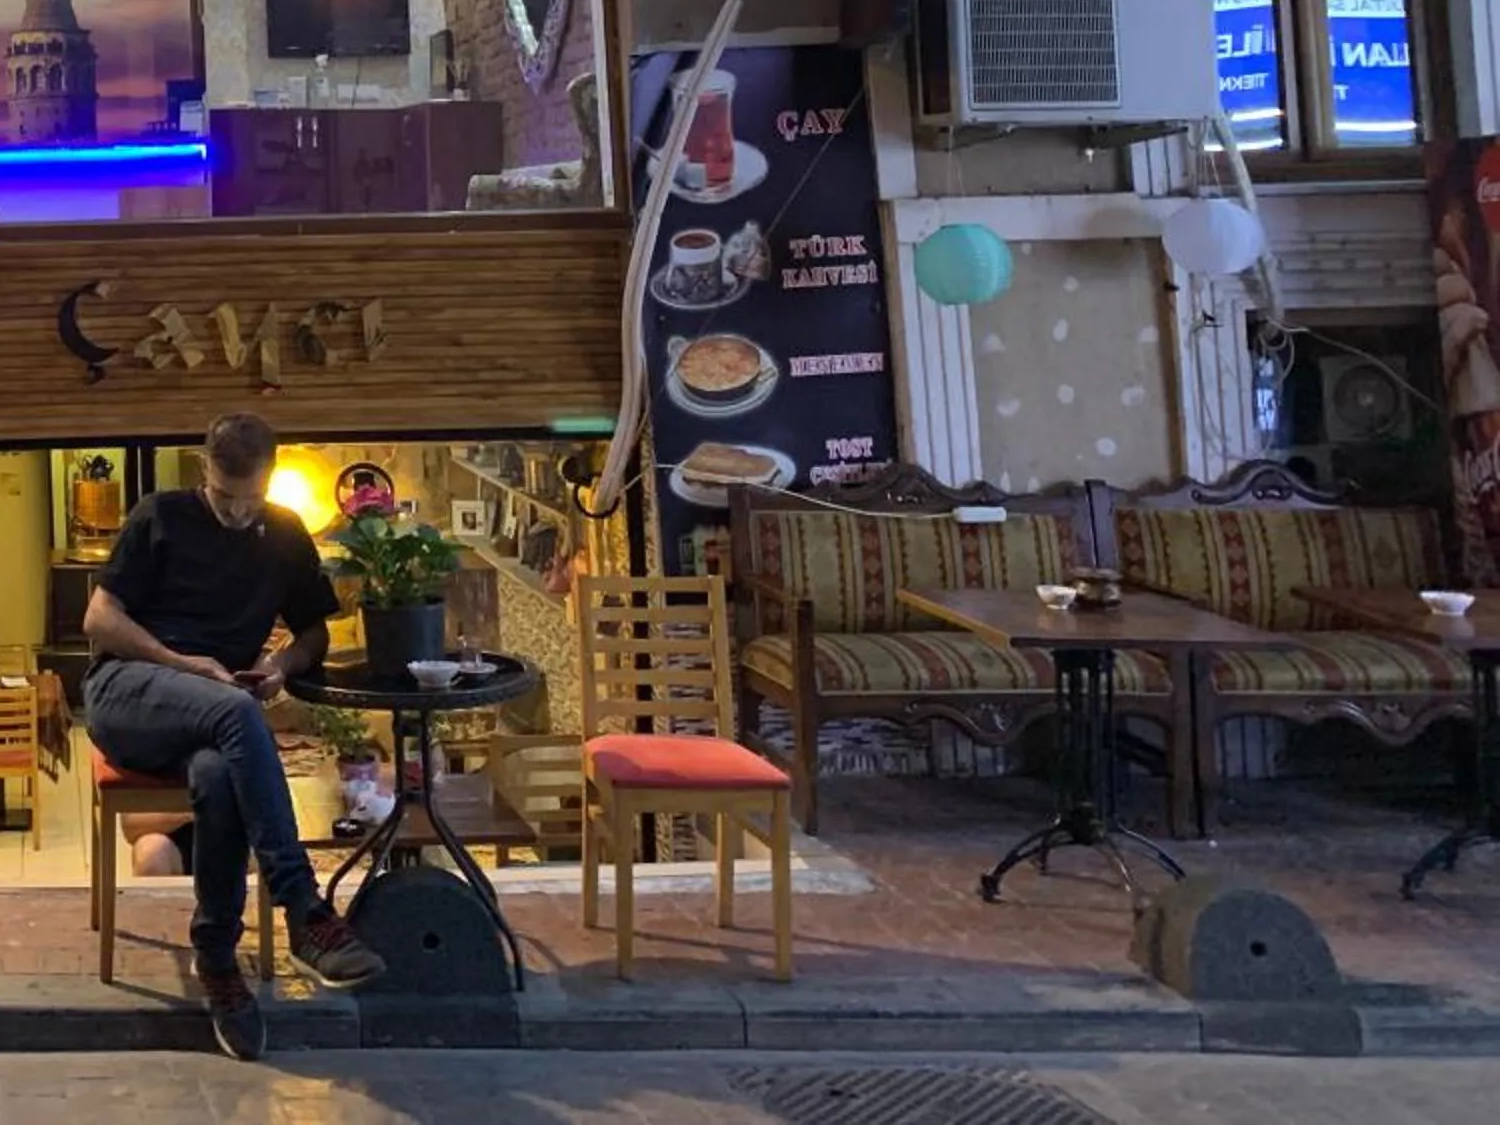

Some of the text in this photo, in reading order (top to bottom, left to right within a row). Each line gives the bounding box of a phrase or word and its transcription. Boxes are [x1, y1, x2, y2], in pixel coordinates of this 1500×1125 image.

[776, 108, 846, 142] ÇAY
[789, 234, 867, 259] TÜRK
[781, 259, 878, 290] KAHVESİ
[825, 436, 873, 460] TOST
